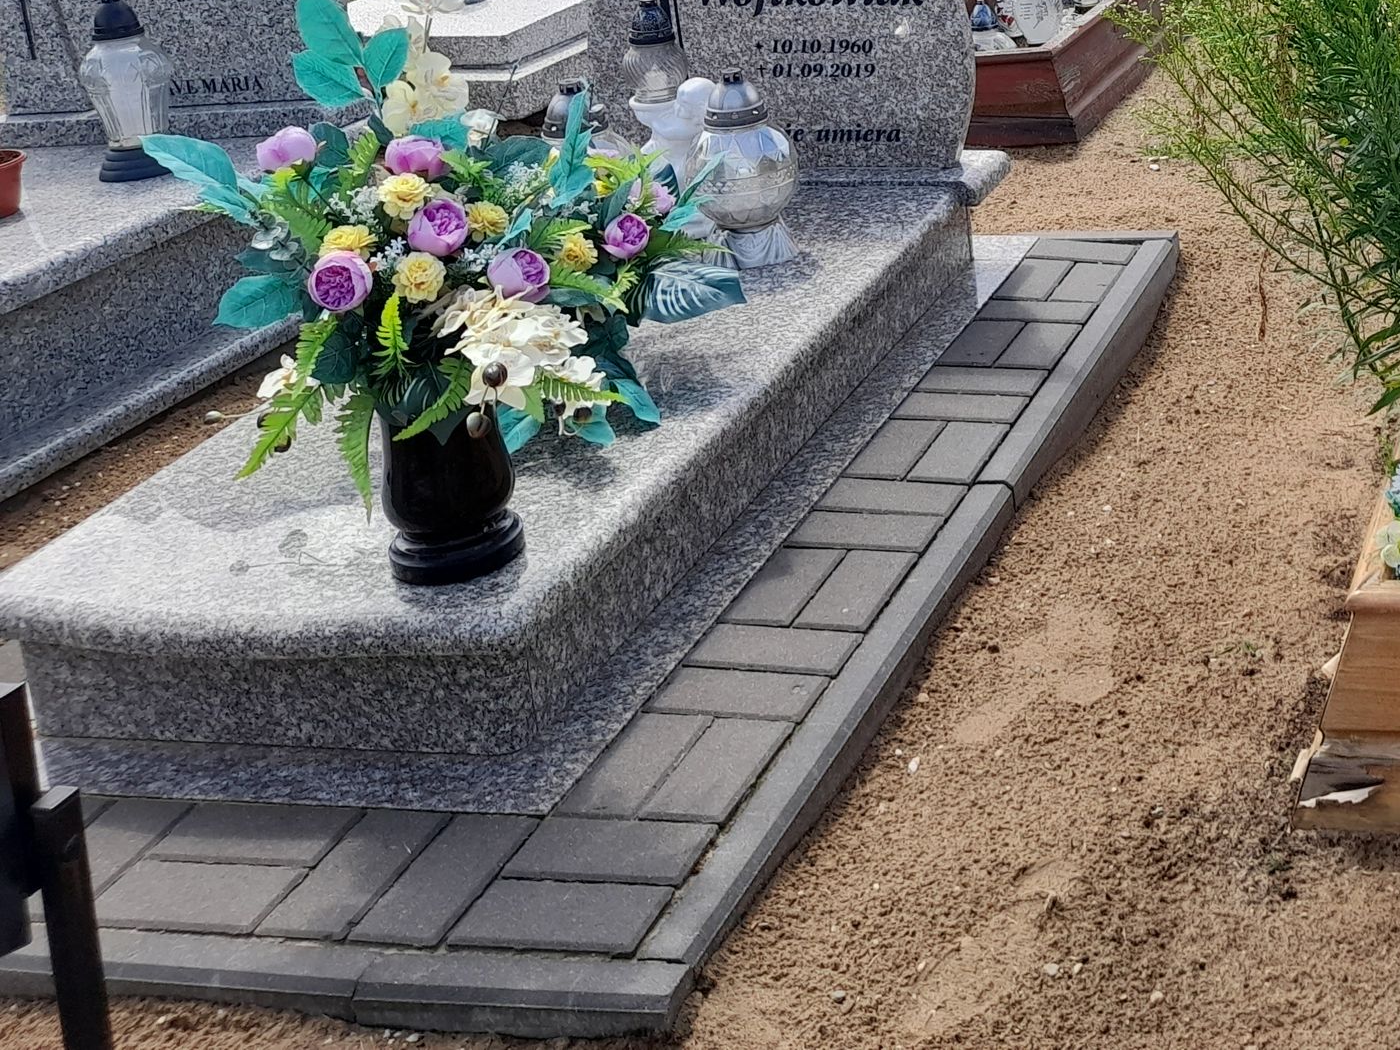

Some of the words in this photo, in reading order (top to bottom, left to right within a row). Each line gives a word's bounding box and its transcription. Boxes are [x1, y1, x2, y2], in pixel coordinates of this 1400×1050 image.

[772, 38, 874, 55] 10.10.1960
[772, 62, 876, 79] 01.09.2019
[201, 76, 263, 94] MARIA
[816, 123, 901, 143] umiera
